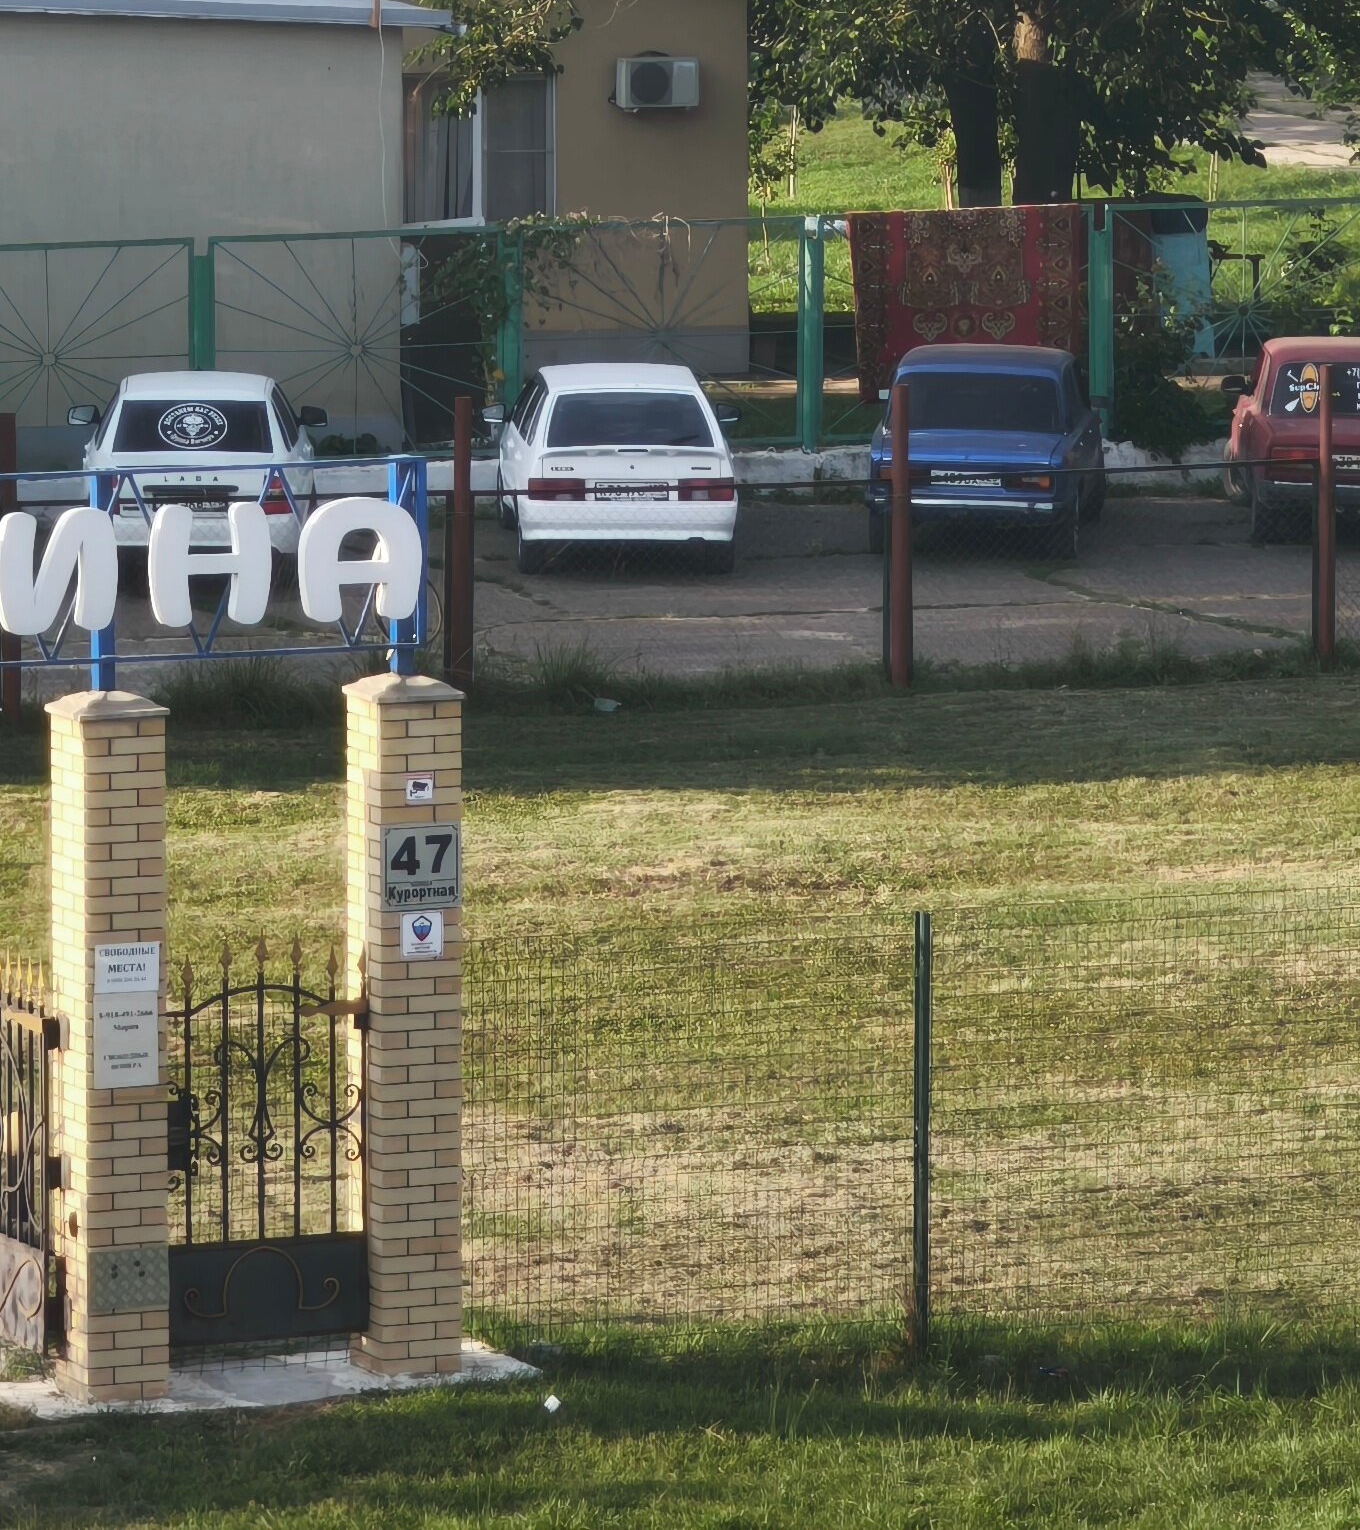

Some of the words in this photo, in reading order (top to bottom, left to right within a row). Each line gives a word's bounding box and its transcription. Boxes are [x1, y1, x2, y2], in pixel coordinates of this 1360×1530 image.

[390, 834, 453, 876] 47
[388, 884, 457, 905] Курортная
[99, 947, 156, 958] СВОБОДНЫЕ
